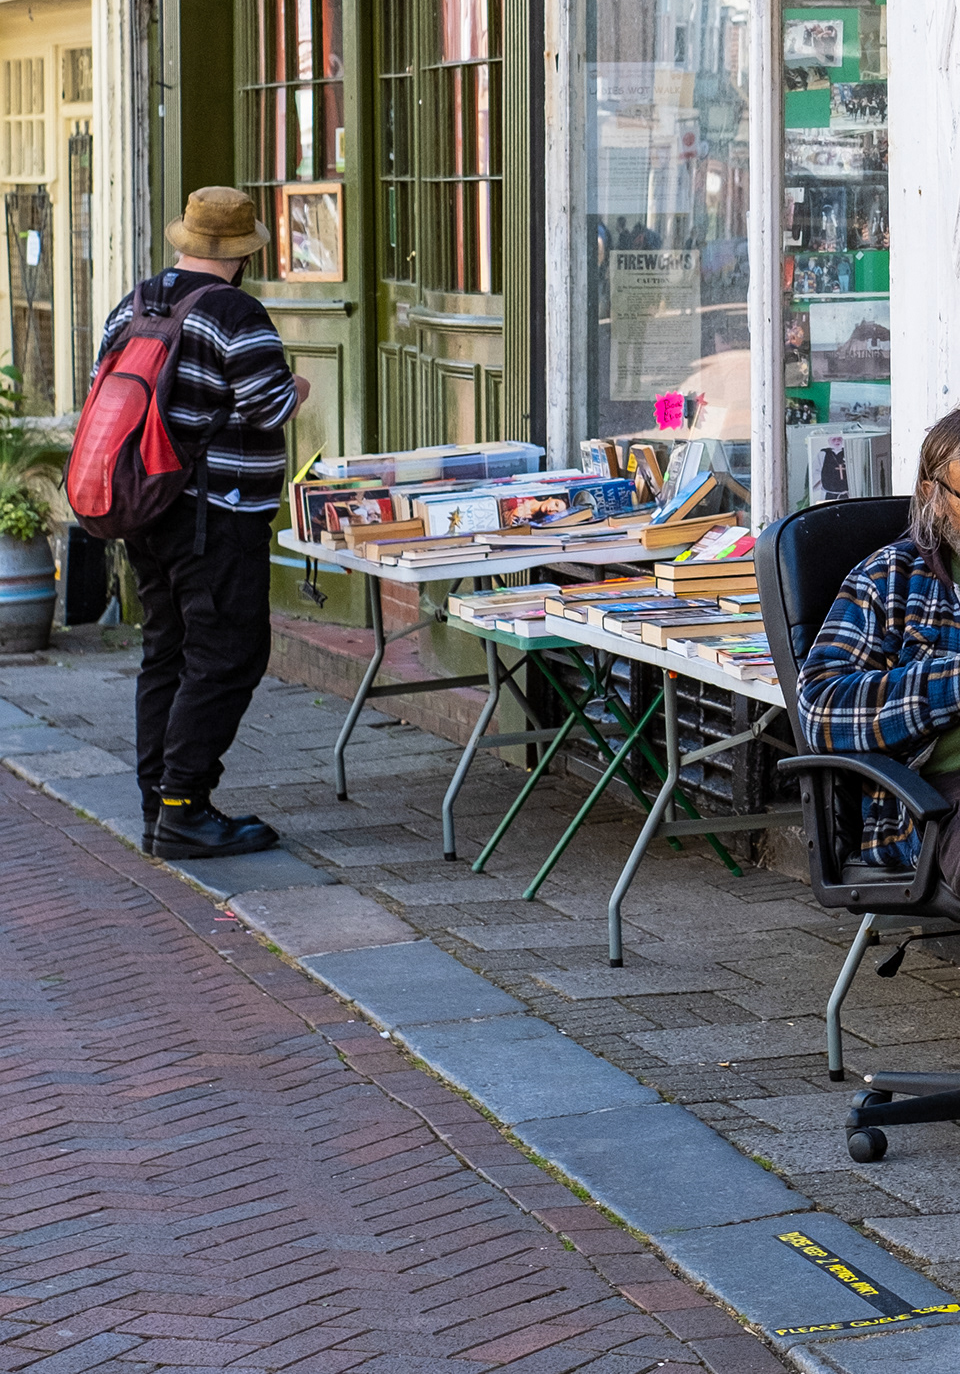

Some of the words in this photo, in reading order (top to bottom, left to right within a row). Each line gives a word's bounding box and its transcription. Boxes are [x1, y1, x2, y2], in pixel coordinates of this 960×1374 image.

[801, 1245, 828, 1258] KEEP
[774, 1322, 845, 1337] PLEASE
[849, 1313, 914, 1328] QUEUE
